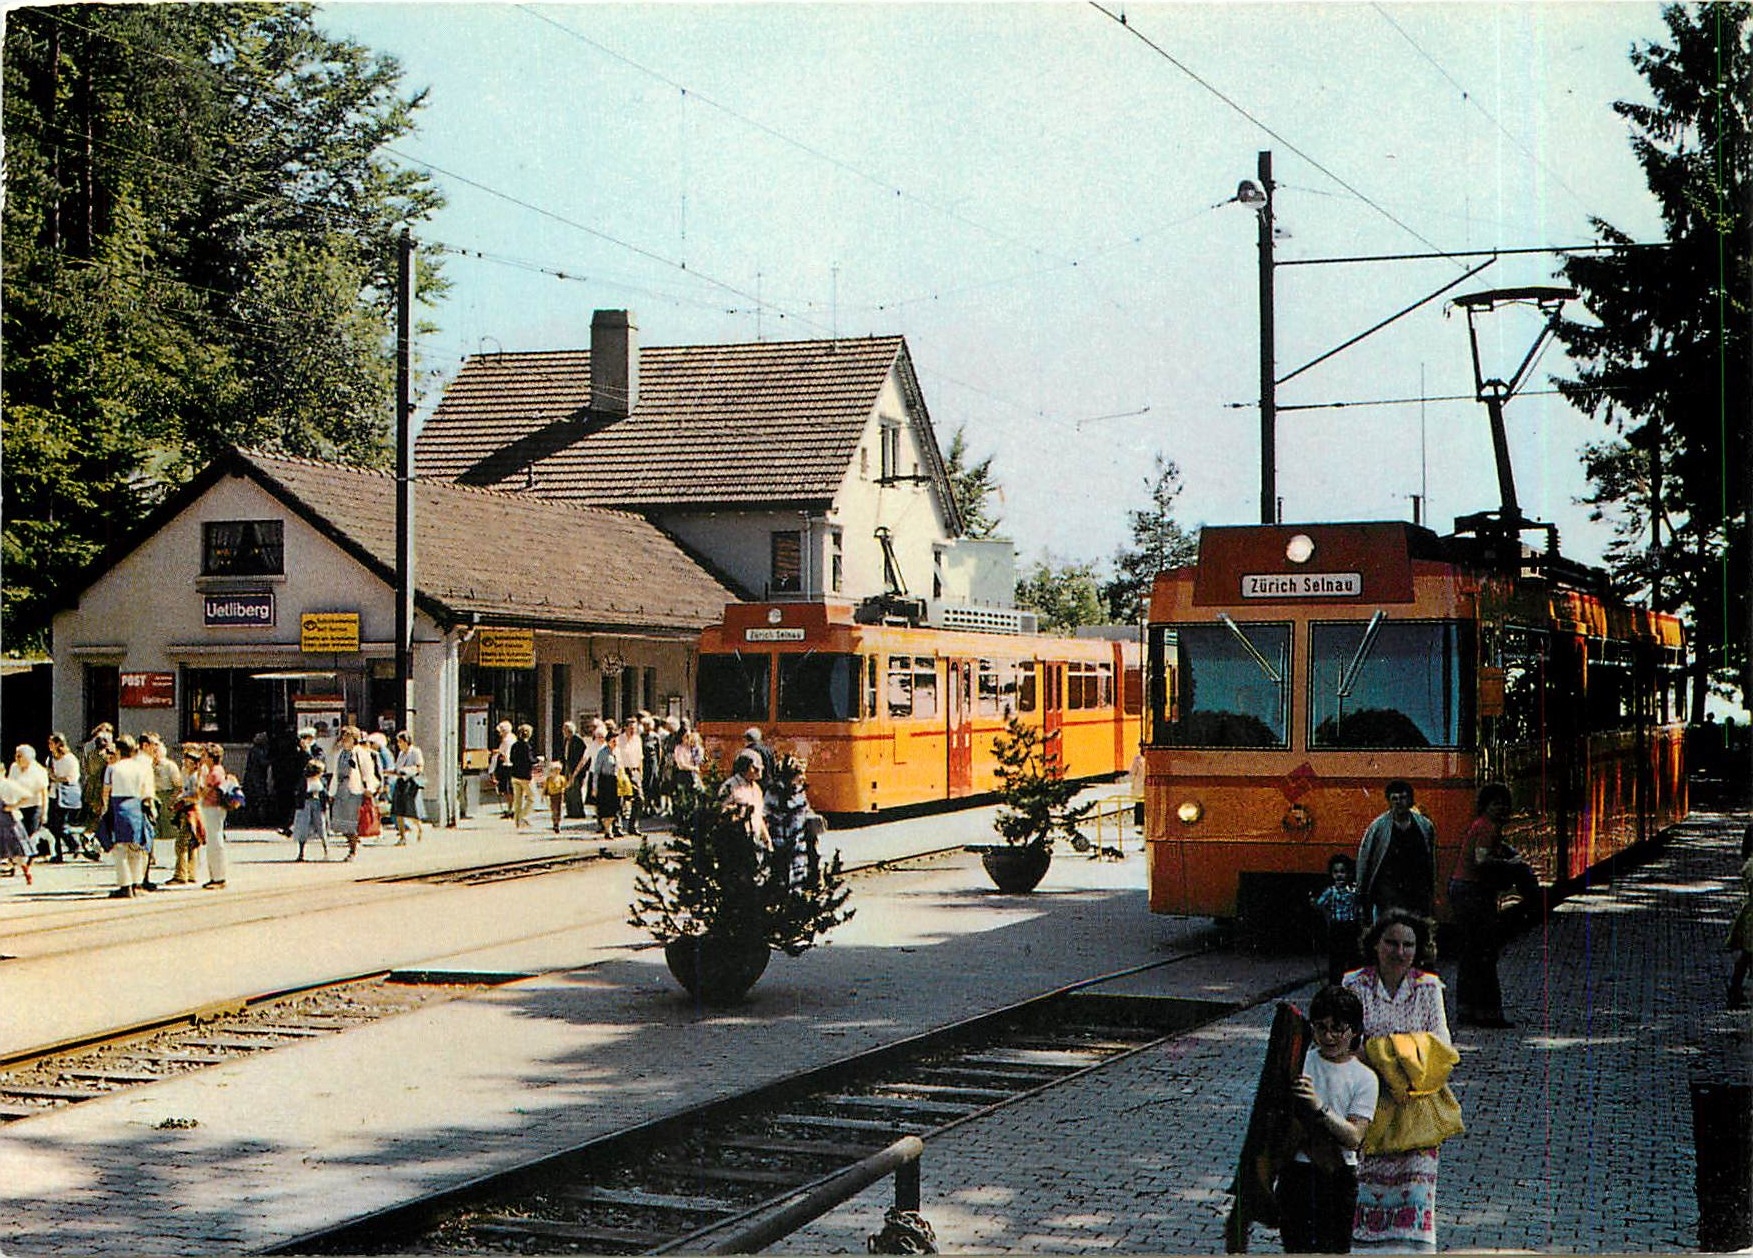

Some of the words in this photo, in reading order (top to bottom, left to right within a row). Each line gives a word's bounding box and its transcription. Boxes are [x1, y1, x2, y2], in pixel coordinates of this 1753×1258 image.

[1250, 577, 1297, 593] Zürich
[1304, 576, 1353, 592] Selnau
[206, 601, 269, 619] Uetliberg
[121, 674, 147, 687] POST
